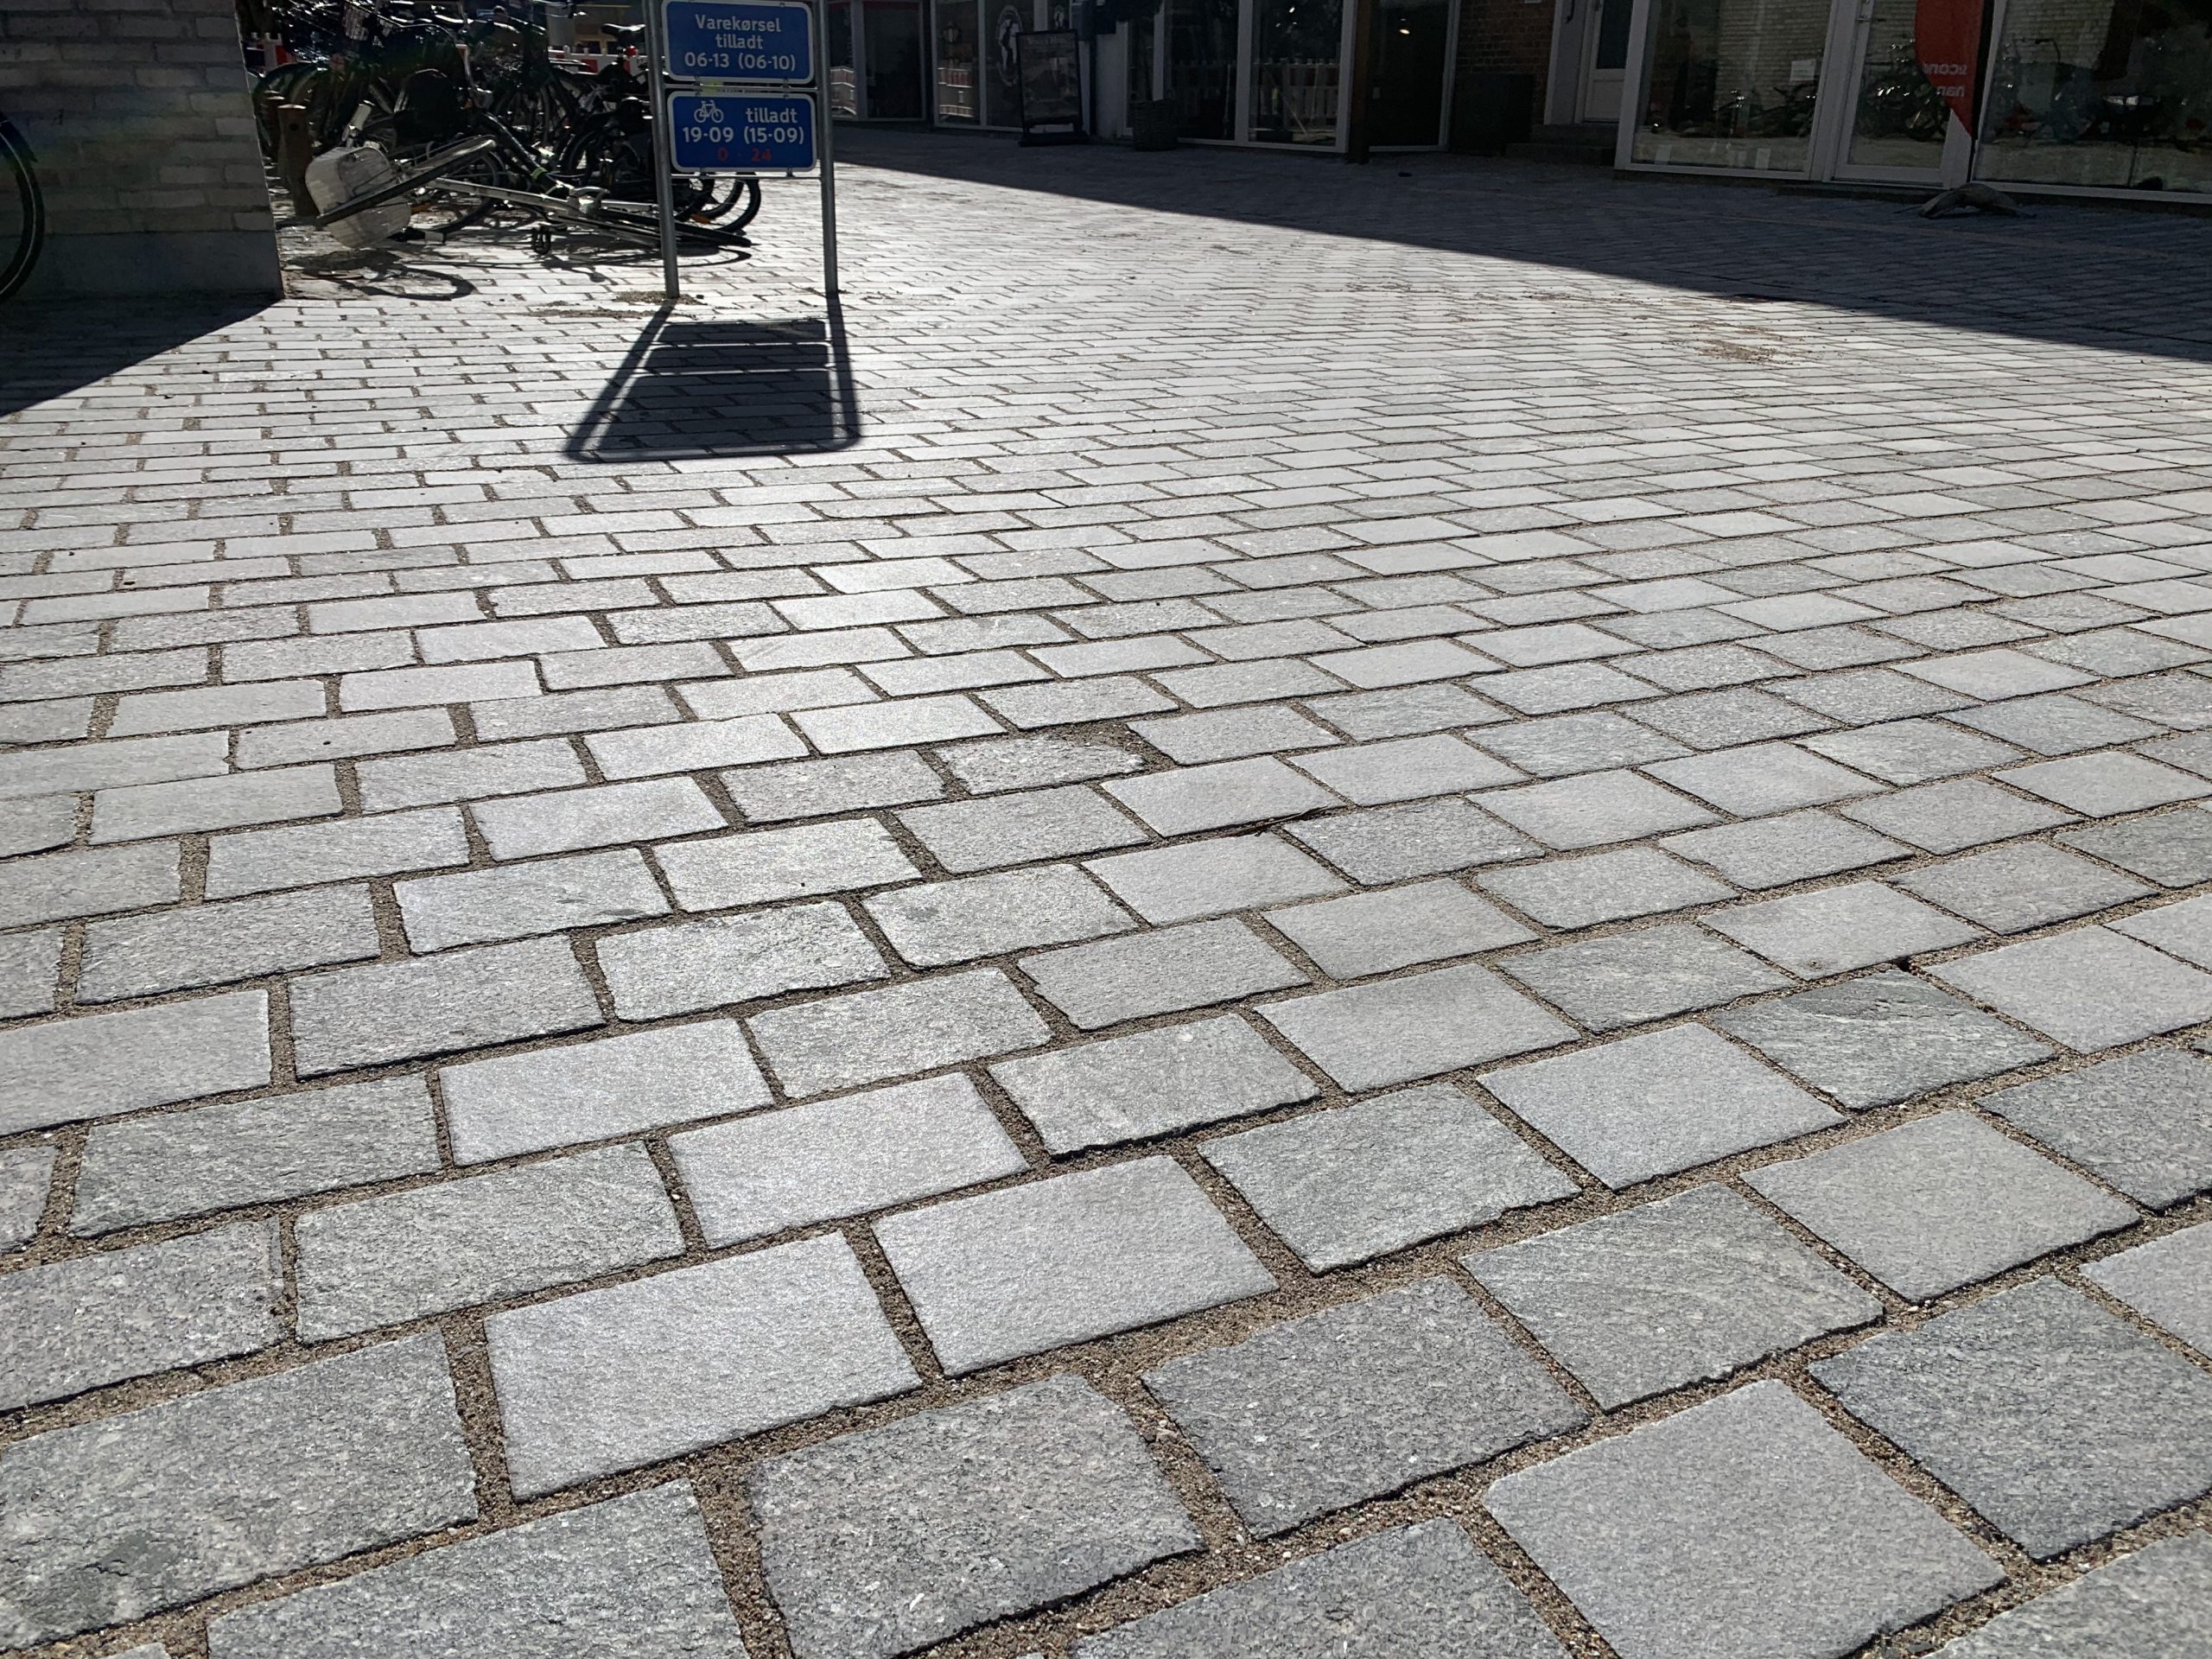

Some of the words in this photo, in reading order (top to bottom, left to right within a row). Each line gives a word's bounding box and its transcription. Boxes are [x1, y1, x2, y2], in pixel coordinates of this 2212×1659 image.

[695, 14, 781, 32] Varekørsel
[715, 34, 764, 49] tilladt
[684, 52, 729, 67] 06-13
[738, 53, 796, 71] (06-10)
[746, 108, 798, 124] tilladt
[683, 127, 734, 143] 19-09
[743, 126, 804, 144] (15-09)
